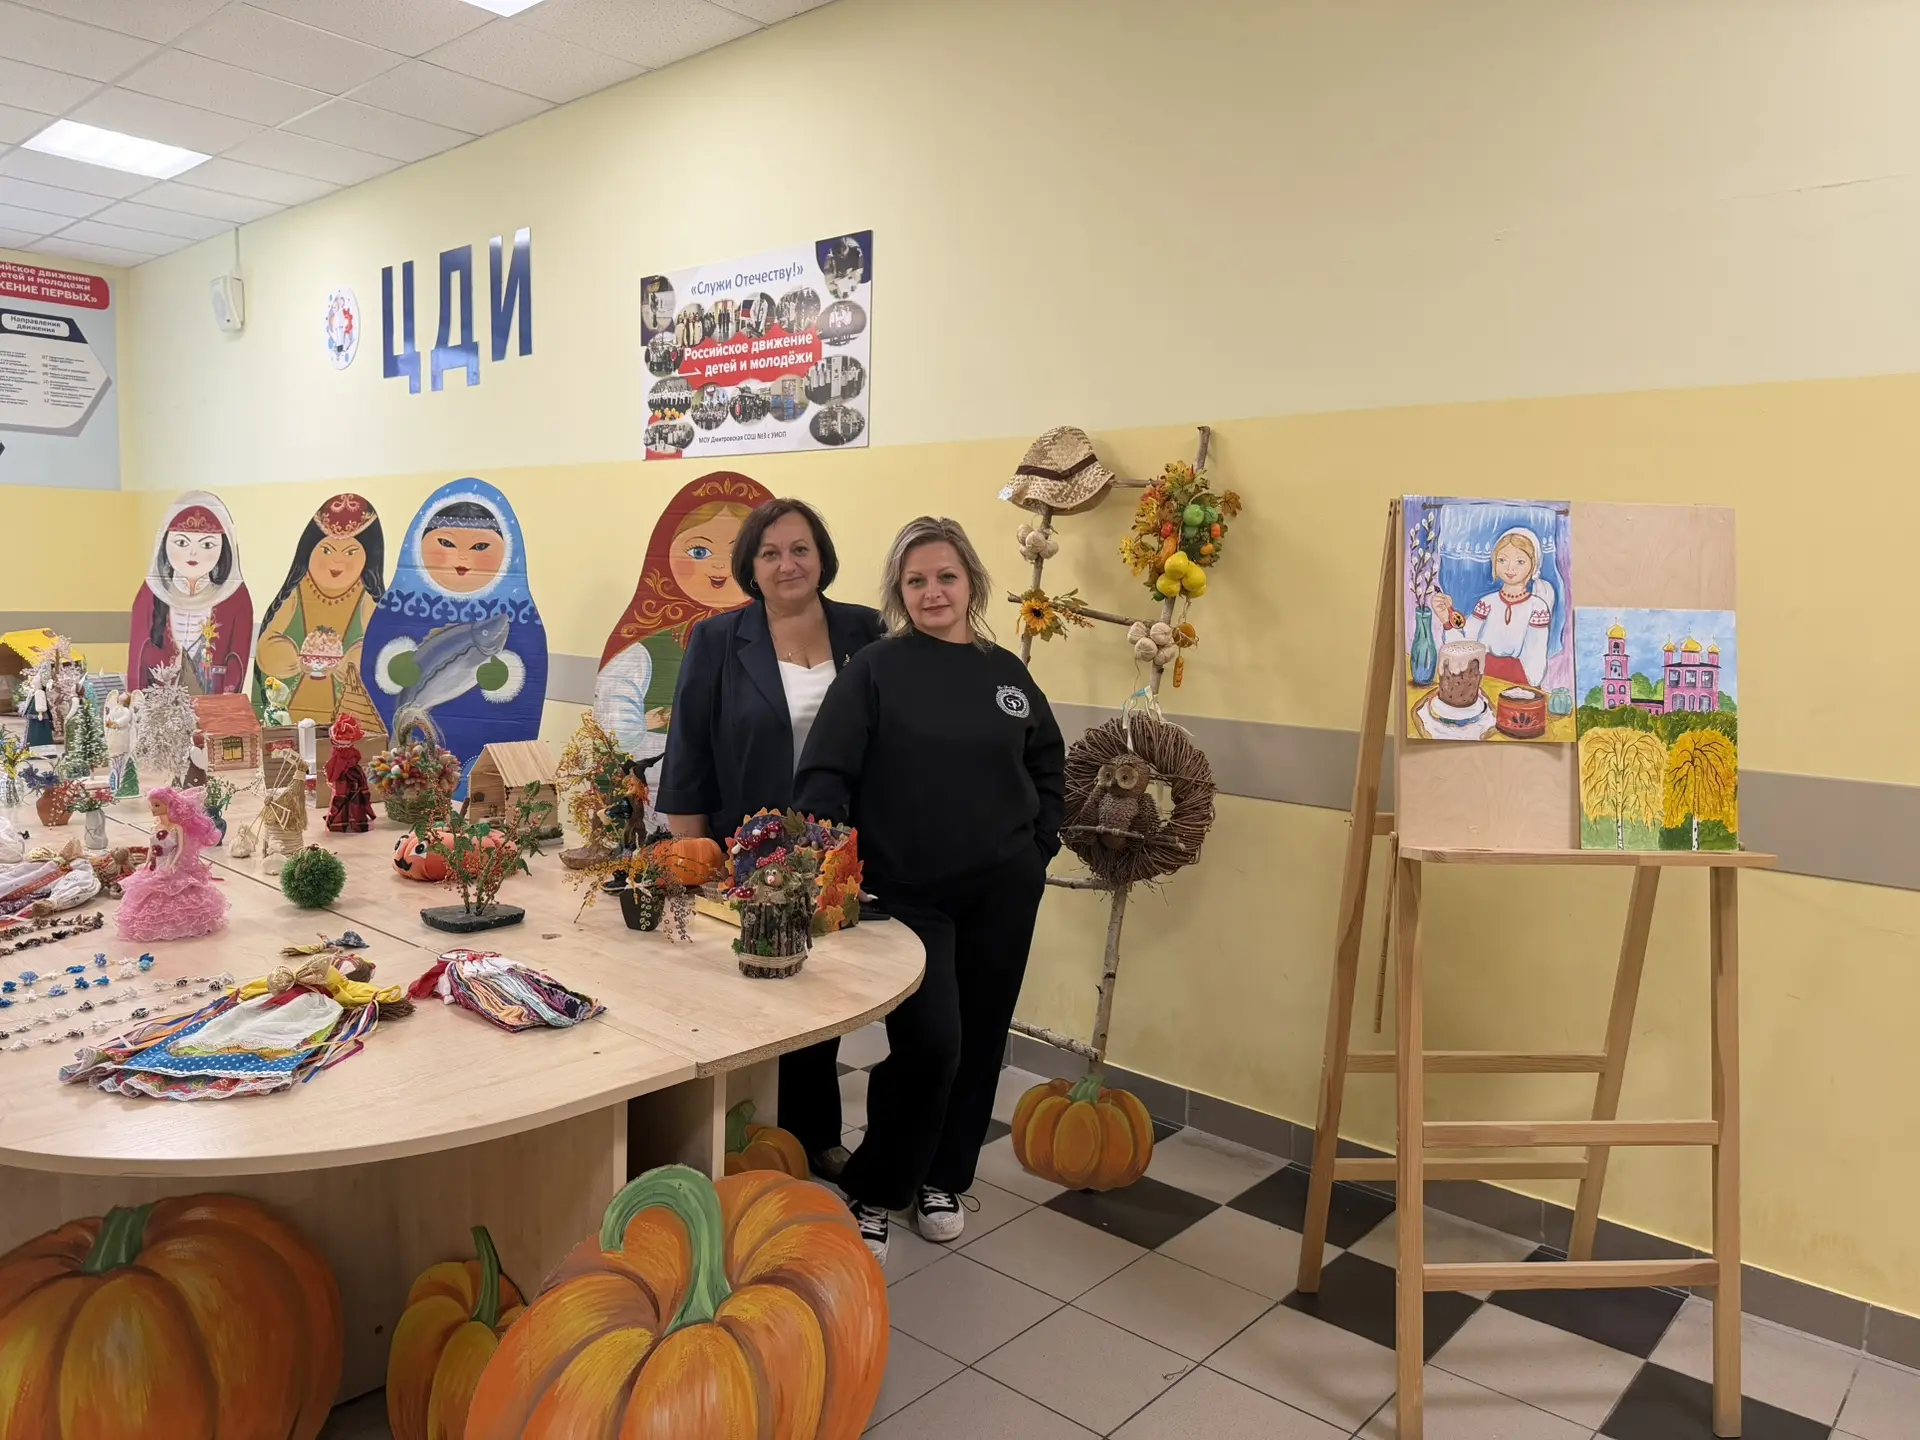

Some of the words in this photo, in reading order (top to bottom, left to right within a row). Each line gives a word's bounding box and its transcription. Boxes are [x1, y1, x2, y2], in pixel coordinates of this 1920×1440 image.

[0, 271, 25, 281] етей
[38, 269, 91, 283] движение
[690, 279, 732, 296] «Служи
[735, 262, 804, 287] Отечеству!»
[41, 286, 97, 303] ПЕРВЫХ»
[381, 226, 532, 394] ЦДИ
[11, 315, 61, 328] Направления
[17, 323, 56, 333] движения
[684, 343, 749, 361] Российское
[751, 332, 813, 354] движение
[705, 359, 737, 377] детей
[740, 361, 747, 371] и
[750, 350, 813, 370] молодёжи
[699, 436, 711, 444] МОУ
[711, 435, 743, 444] Дмитровская
[744, 433, 756, 441] СОШ
[771, 431, 787, 439] УИОП
